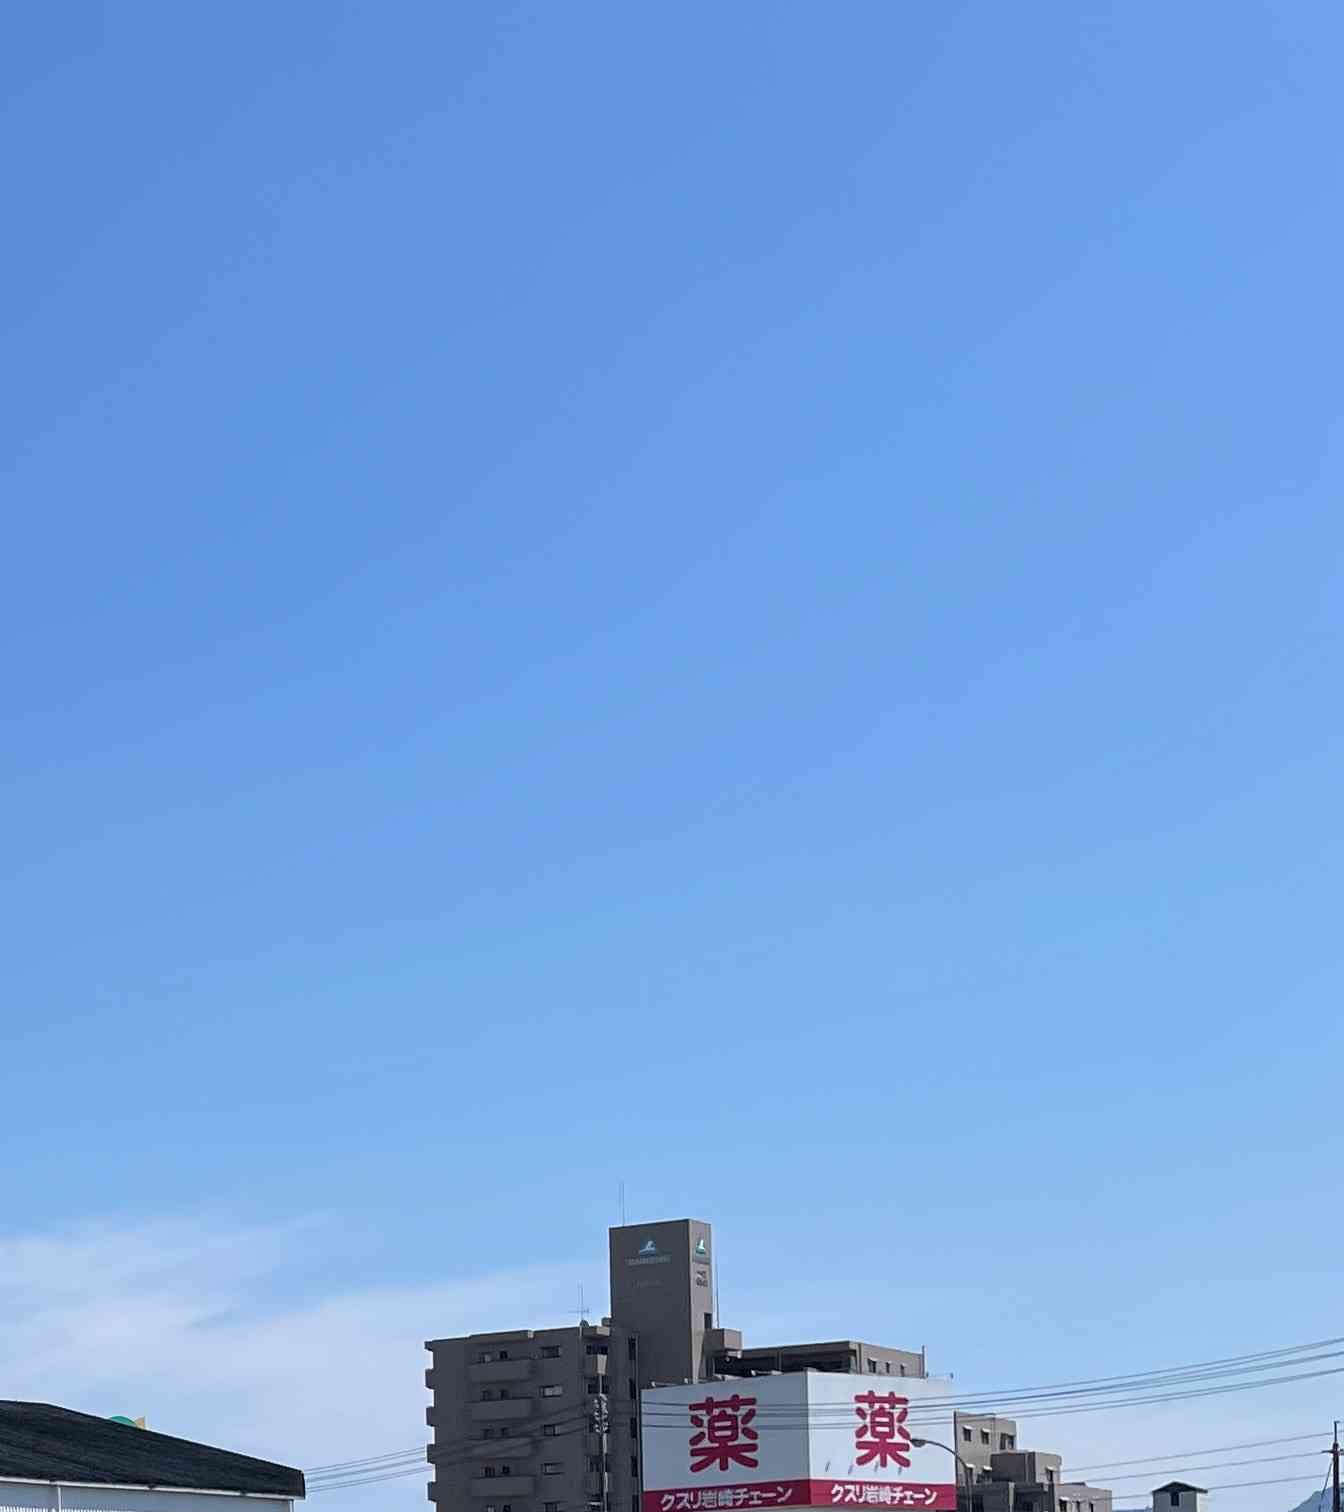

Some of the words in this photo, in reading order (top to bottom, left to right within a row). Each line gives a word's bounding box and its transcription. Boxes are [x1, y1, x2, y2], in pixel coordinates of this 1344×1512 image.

[689, 1394, 759, 1472] 薬
[855, 1390, 910, 1468] 薬
[661, 1486, 792, 1511] クスリ岩崎チェーン
[830, 1484, 937, 1505] クスリ岩崎チェーン
